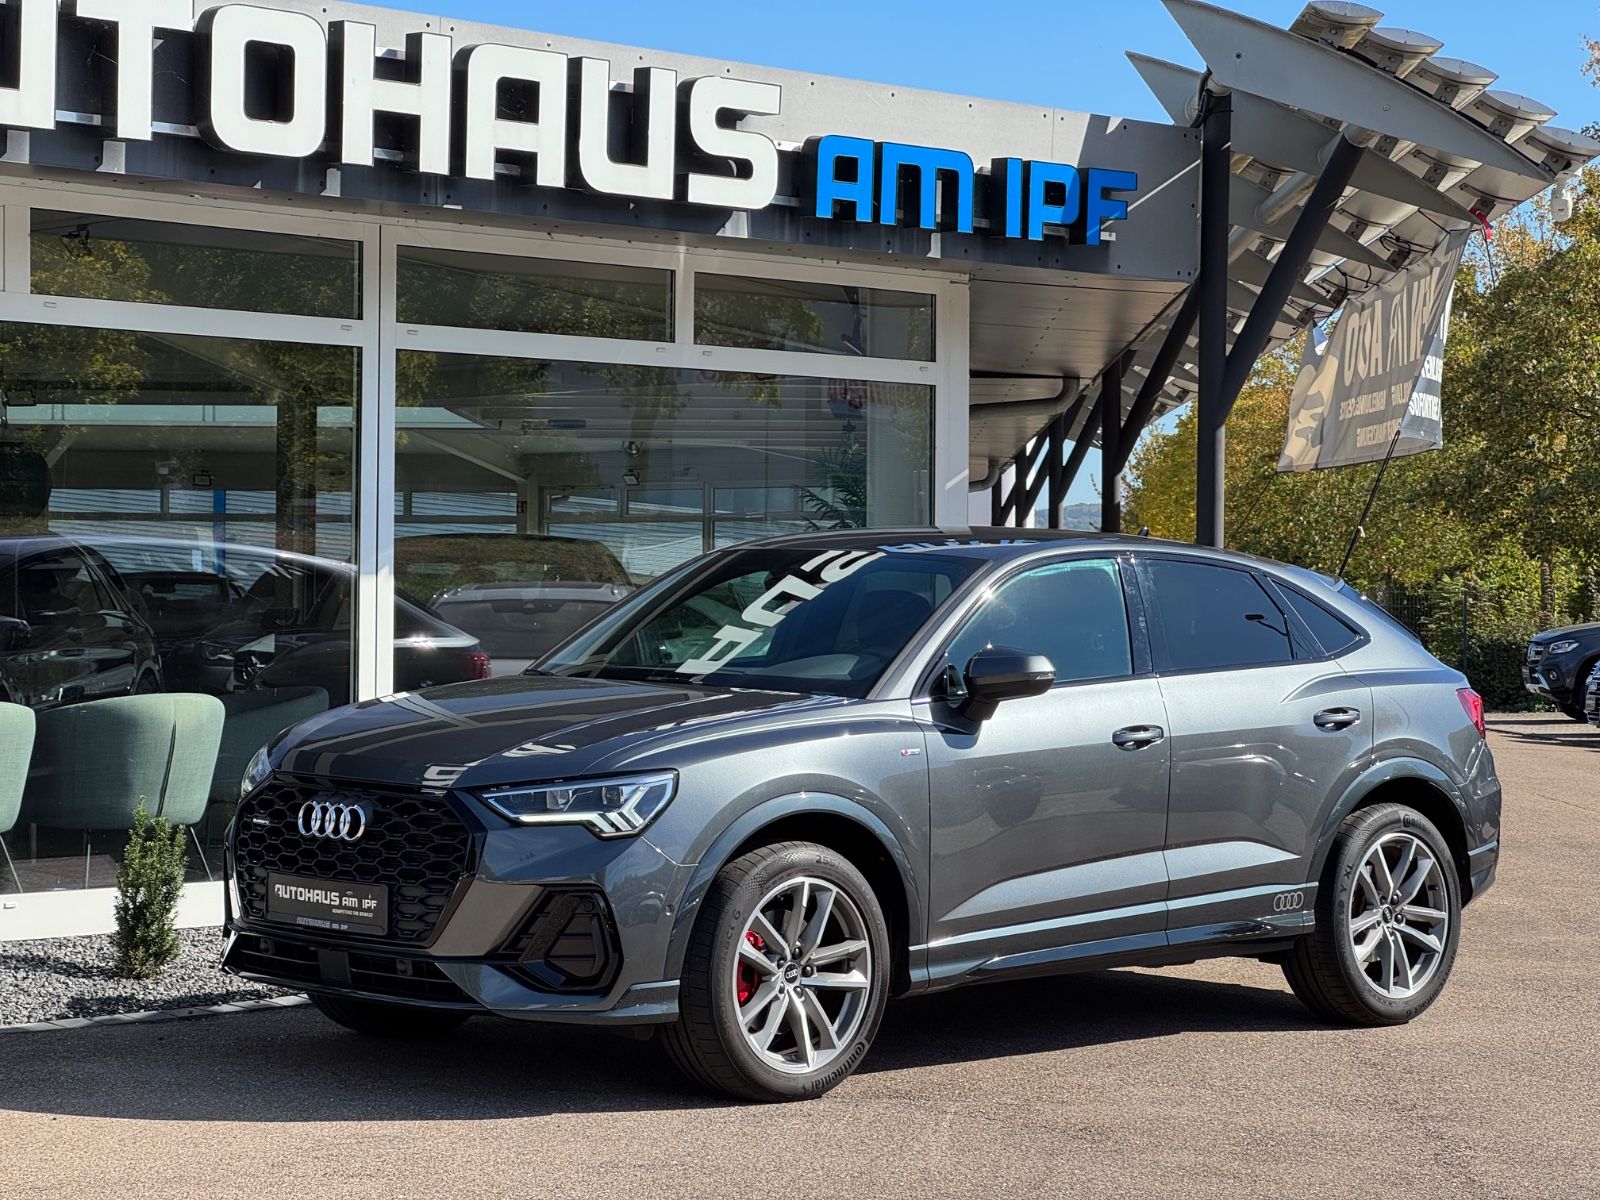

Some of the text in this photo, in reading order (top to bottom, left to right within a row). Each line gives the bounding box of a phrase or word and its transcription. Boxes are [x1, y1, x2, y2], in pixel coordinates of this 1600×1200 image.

[812, 134, 975, 235] AM
[1002, 156, 1138, 246] IPF
[275, 884, 378, 910] AUTOHAUS AM IPF
[811, 1041, 866, 1093] Continental
